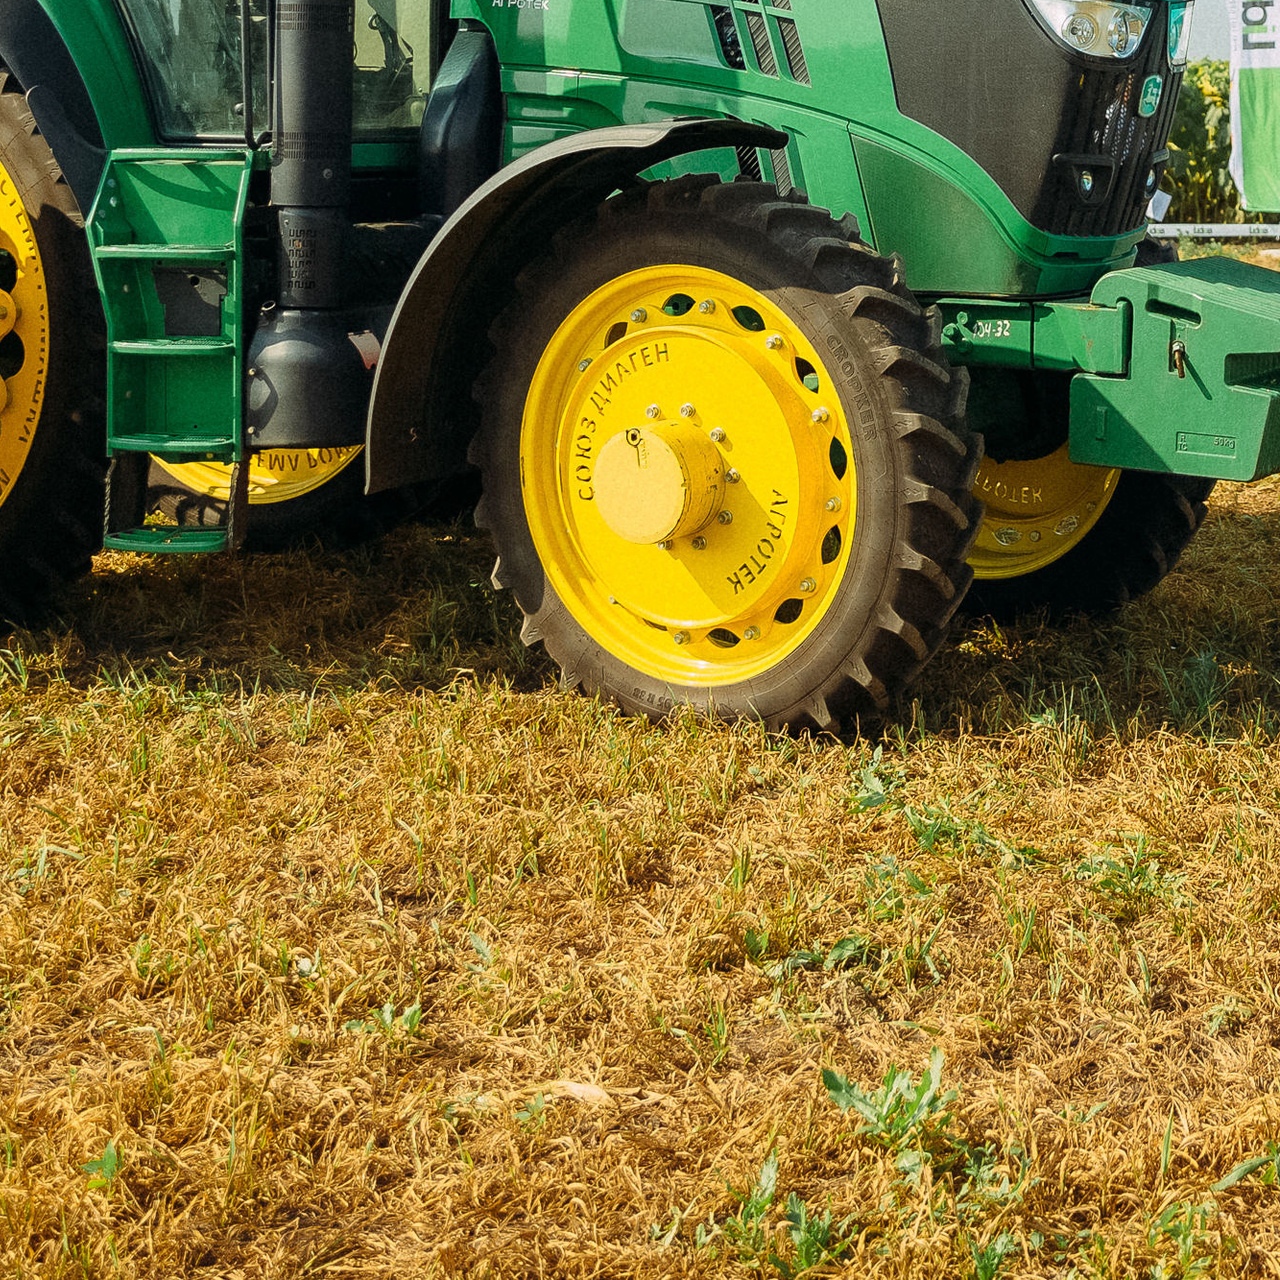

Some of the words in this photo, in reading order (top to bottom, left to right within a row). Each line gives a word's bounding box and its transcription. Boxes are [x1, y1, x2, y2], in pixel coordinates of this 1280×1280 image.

[576, 417, 597, 502] СОЮЗ
[590, 342, 670, 417] ДИАГЕН
[726, 488, 788, 595] АГРОТЕК
